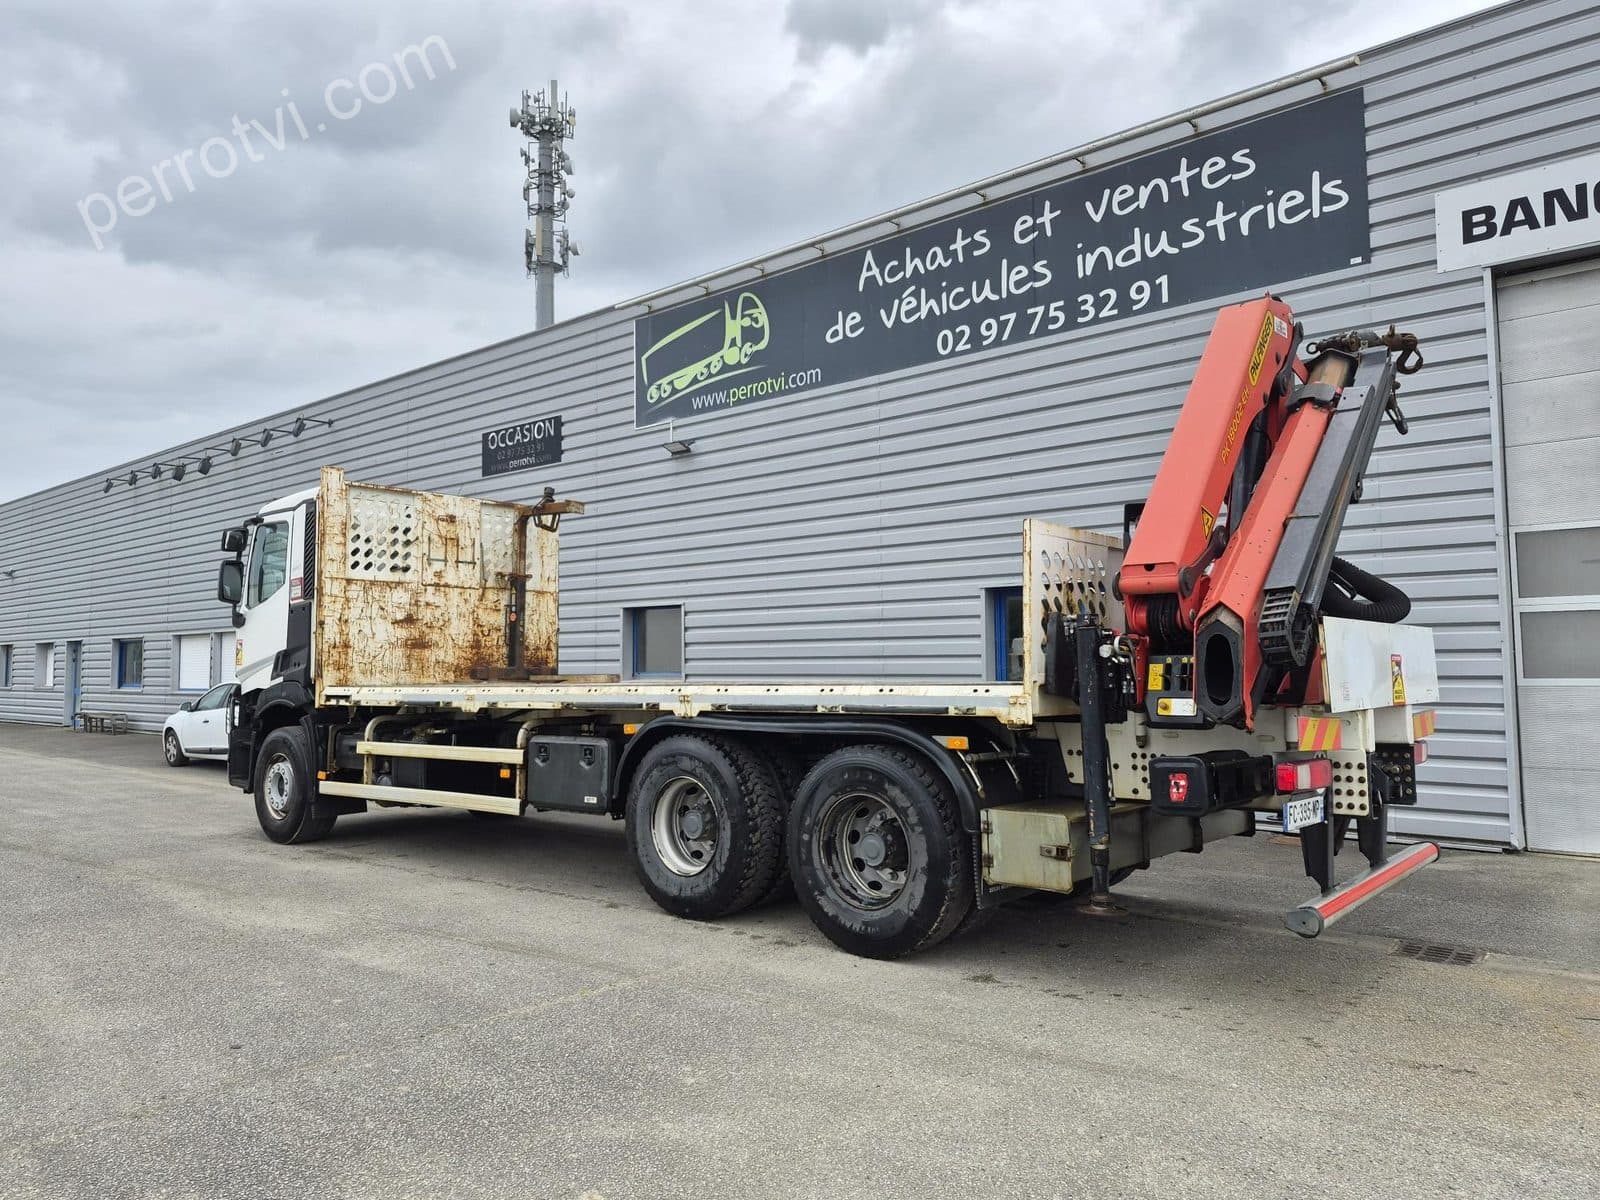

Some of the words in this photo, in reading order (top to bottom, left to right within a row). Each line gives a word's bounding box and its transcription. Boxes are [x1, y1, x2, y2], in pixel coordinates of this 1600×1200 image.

[858, 227, 991, 291] Achats
[1012, 200, 1061, 246] et
[1084, 148, 1256, 224] ventes
[1461, 180, 1600, 245] BAN
[825, 310, 865, 344] de
[880, 258, 1052, 329] véhicules
[1076, 171, 1350, 279] industriels
[936, 326, 972, 355] 02
[981, 313, 1018, 345] 97
[1027, 300, 1066, 335] 75
[1077, 288, 1119, 323] 32
[1130, 274, 1170, 313] 91
[1250, 316, 1273, 382] PALFINGER
[692, 368, 821, 410] www.perrotvi.com
[488, 419, 554, 449] OCCASION
